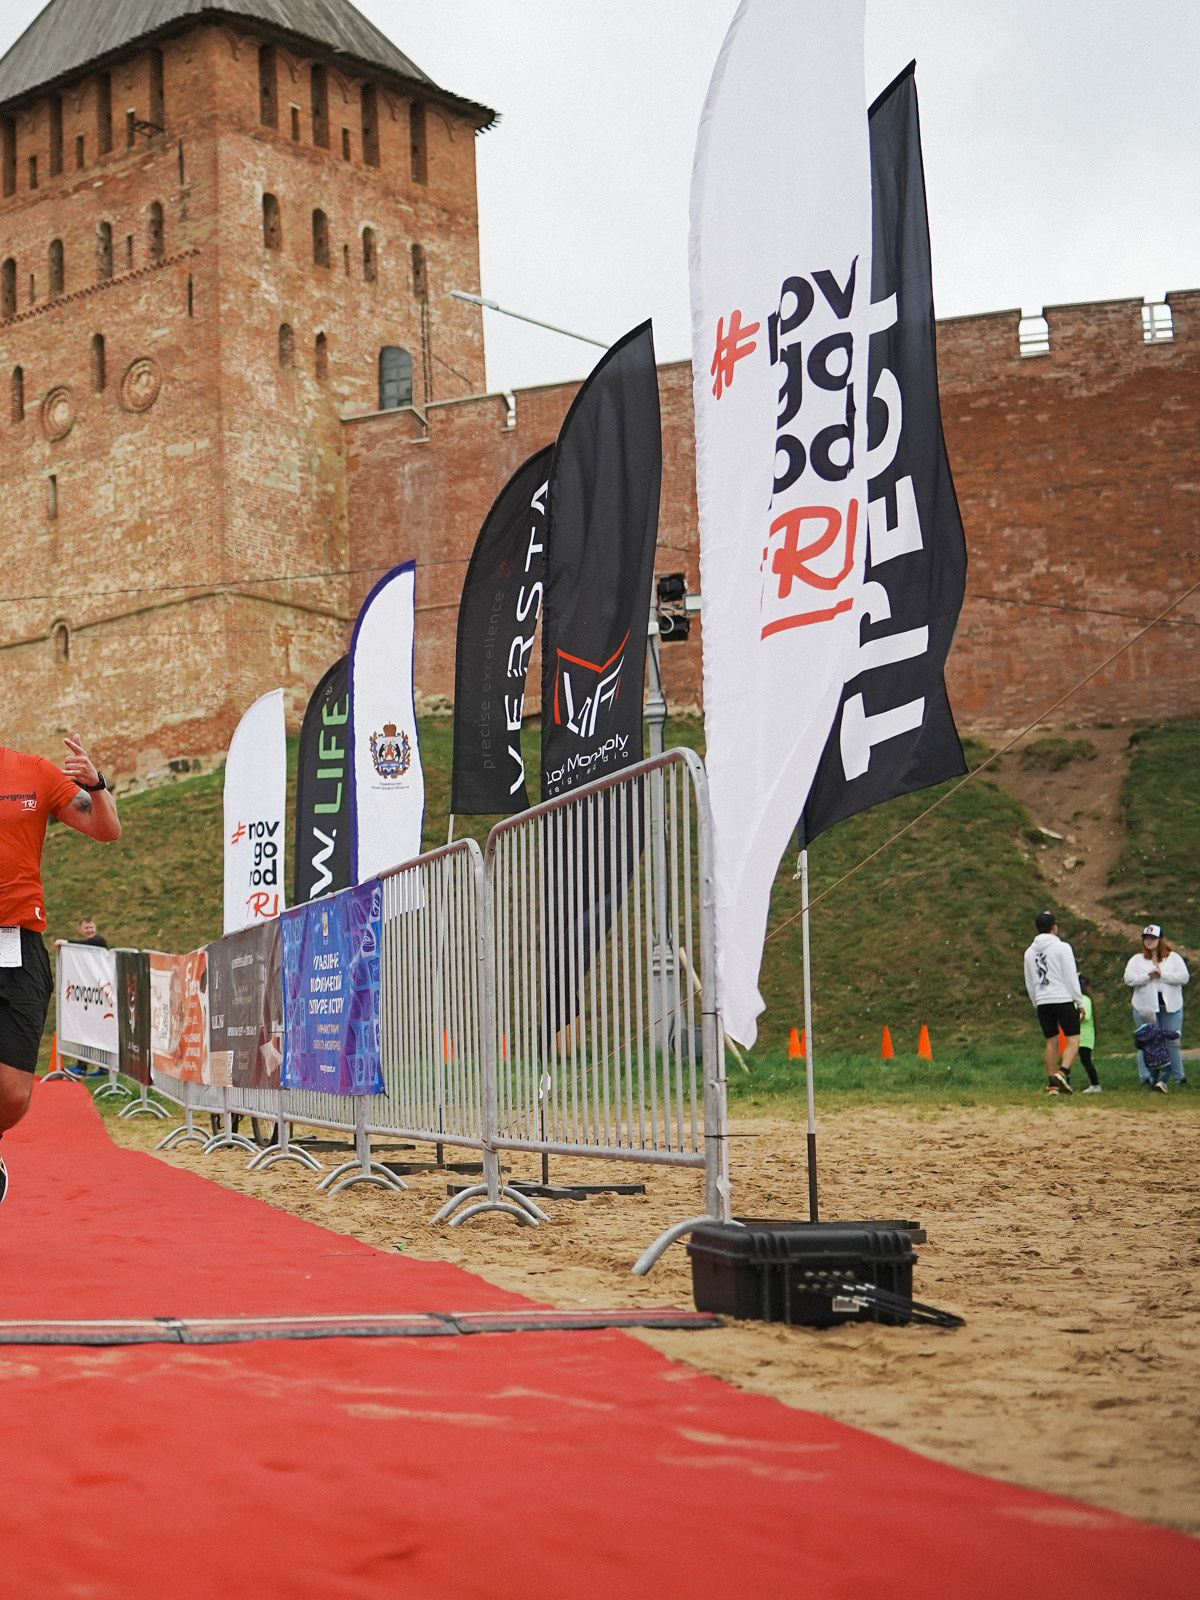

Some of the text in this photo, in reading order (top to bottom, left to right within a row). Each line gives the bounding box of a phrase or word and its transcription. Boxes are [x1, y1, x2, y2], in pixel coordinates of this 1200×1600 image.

[770, 382, 857, 500] od
[761, 498, 859, 611] RI
[505, 479, 549, 795] VERSTA
[313, 692, 350, 815] LIFE
[253, 841, 278, 867] go
